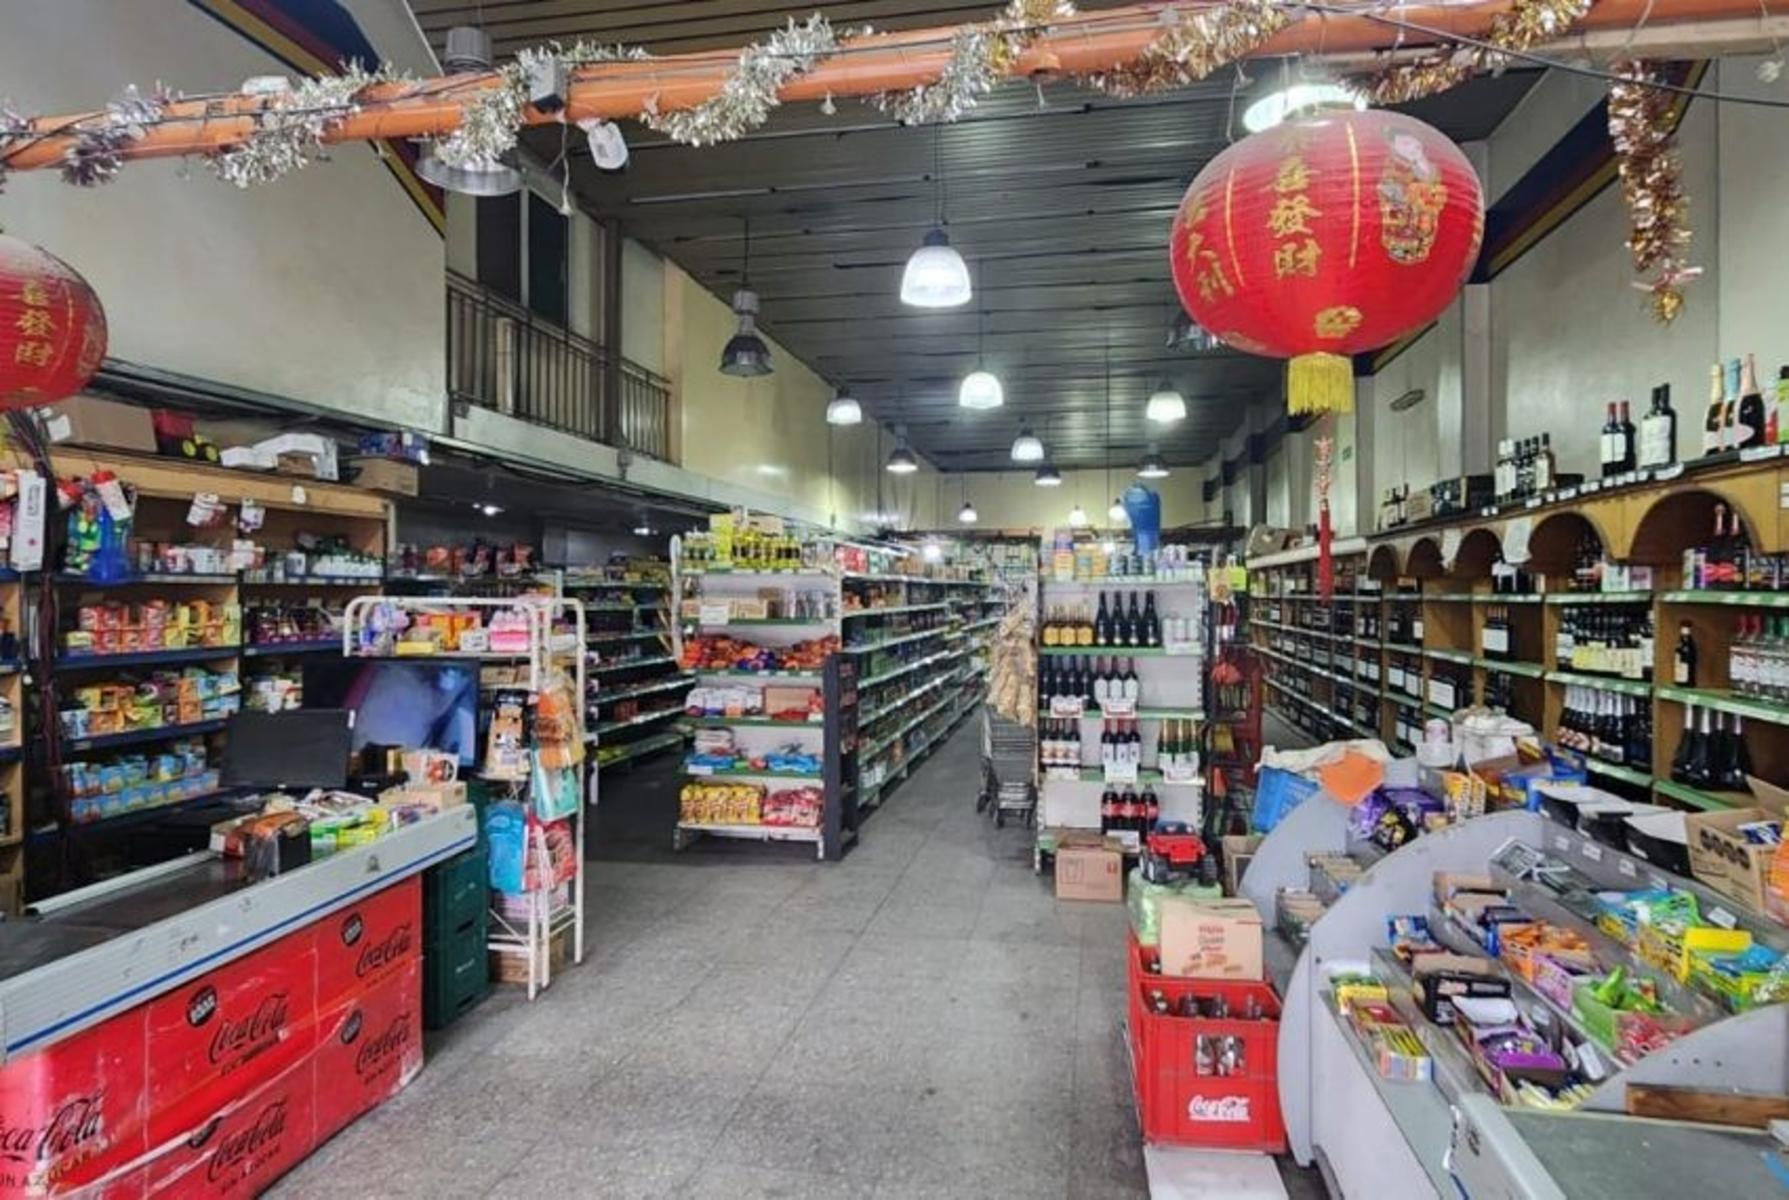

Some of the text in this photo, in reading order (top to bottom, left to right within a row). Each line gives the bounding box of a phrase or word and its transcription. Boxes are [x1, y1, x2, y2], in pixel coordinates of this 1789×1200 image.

[209, 989, 288, 1064] Coca-Cola
[208, 1094, 288, 1182] Coca-Cola
[1189, 1095, 1250, 1121] Coca-Cola
